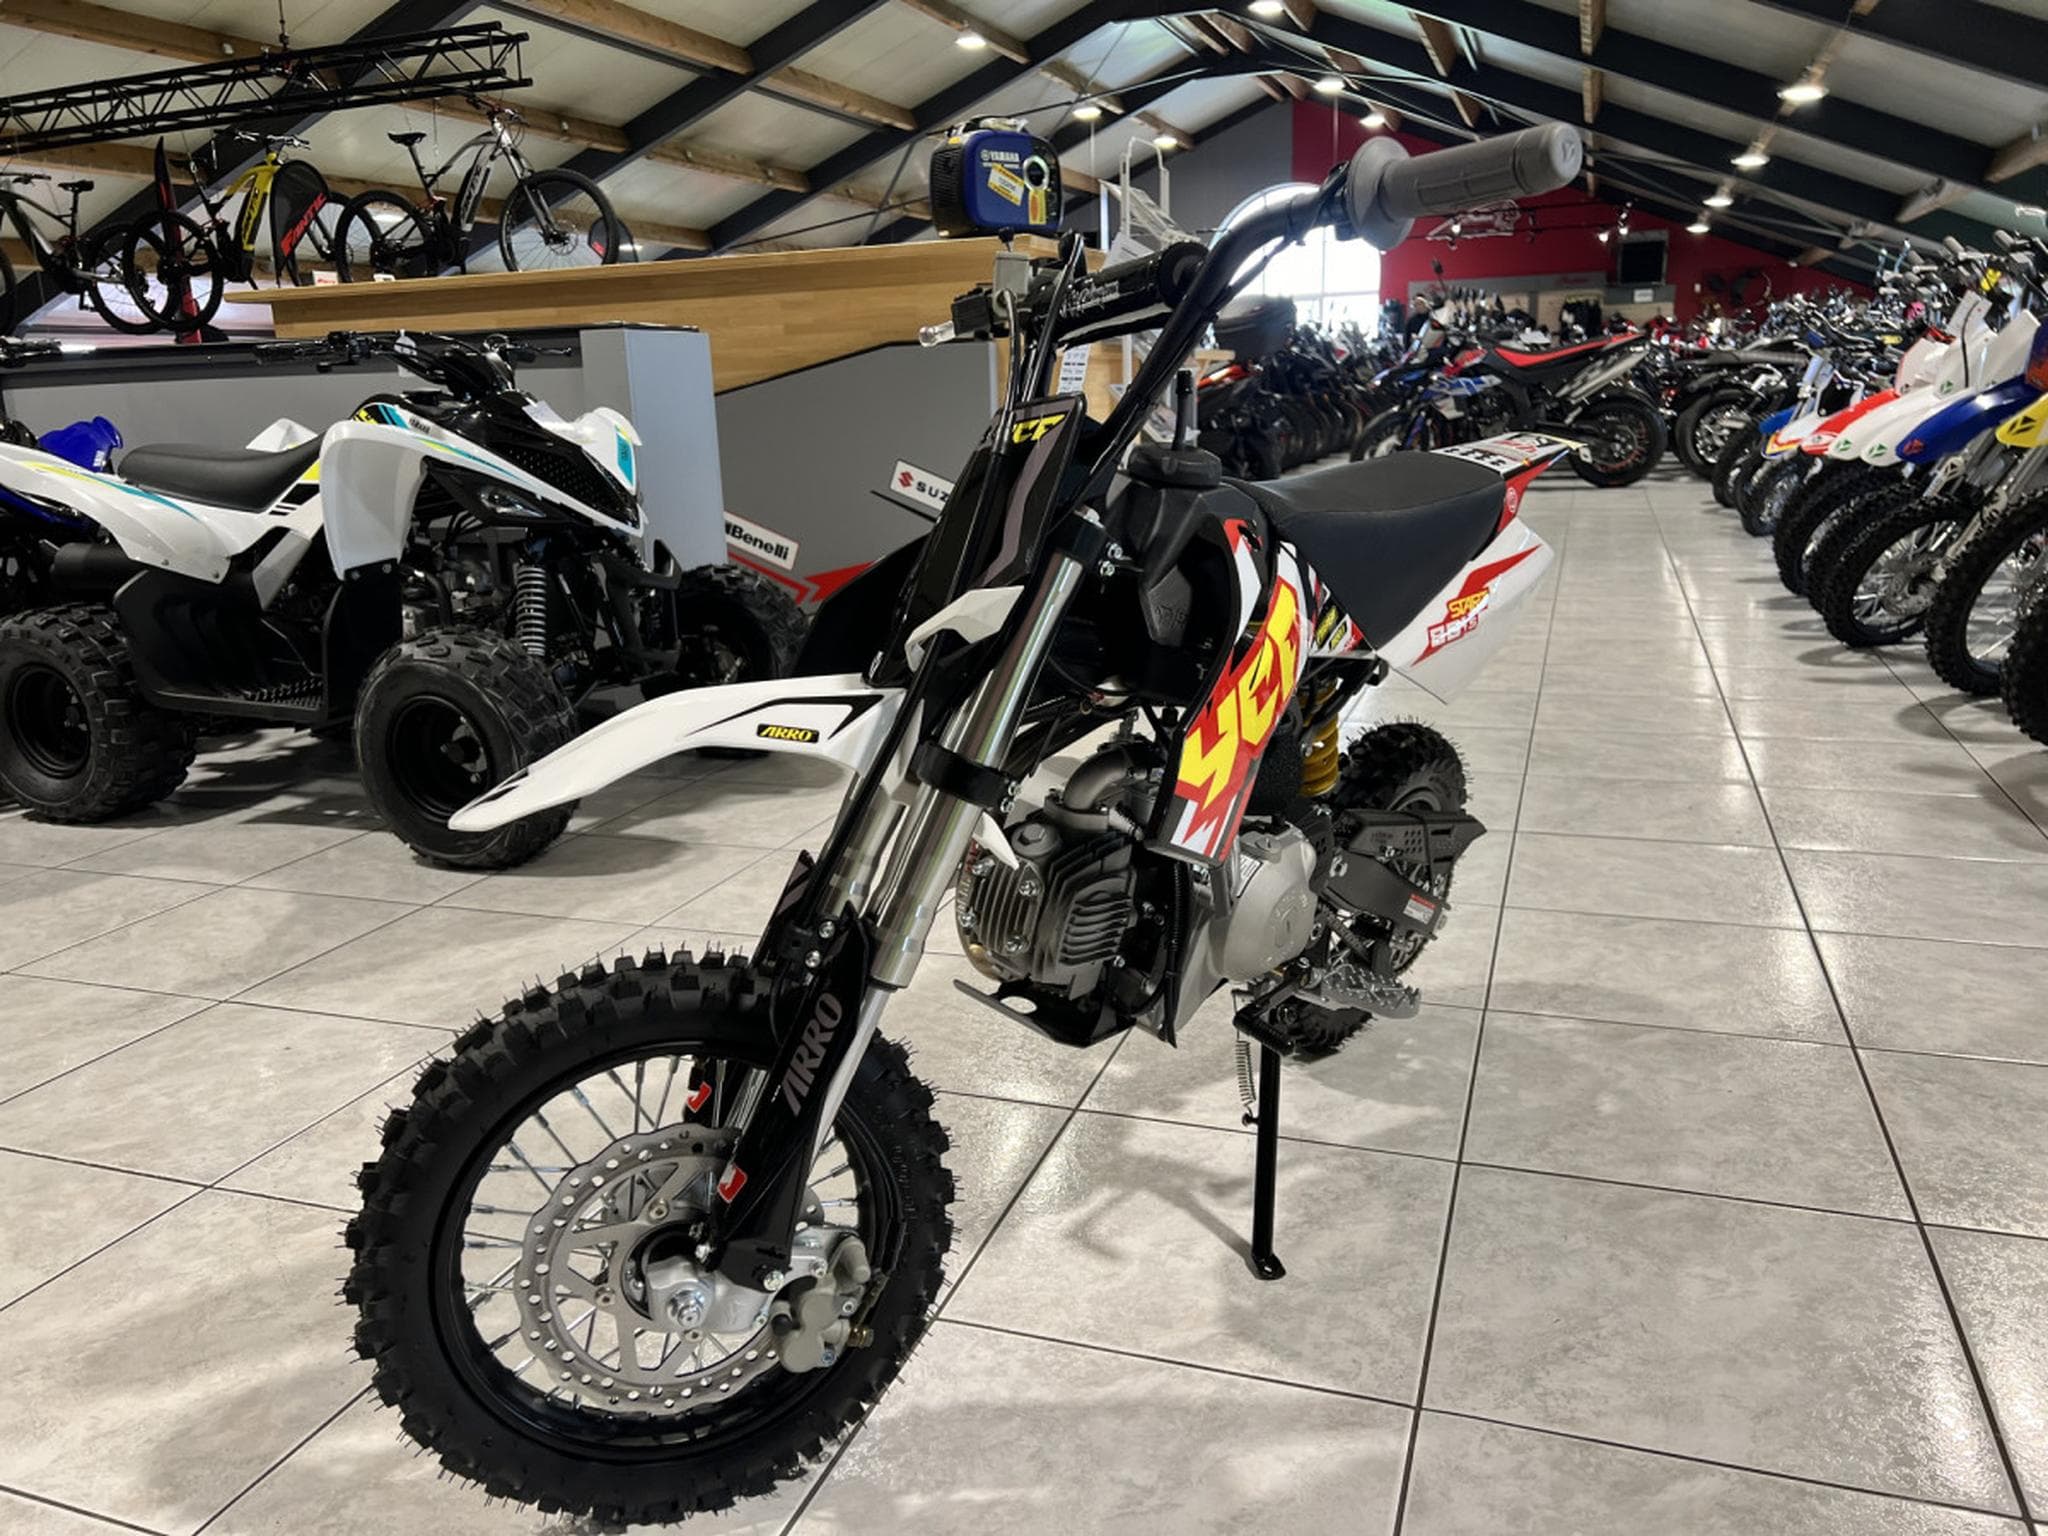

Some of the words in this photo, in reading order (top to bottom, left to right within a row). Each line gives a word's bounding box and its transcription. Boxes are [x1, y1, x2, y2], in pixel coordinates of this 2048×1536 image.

[1012, 414, 1066, 444] CF
[916, 481, 951, 502] SUZ
[730, 523, 790, 561] Benelli
[760, 726, 813, 743] ARRO
[781, 992, 843, 1117] ARRO
